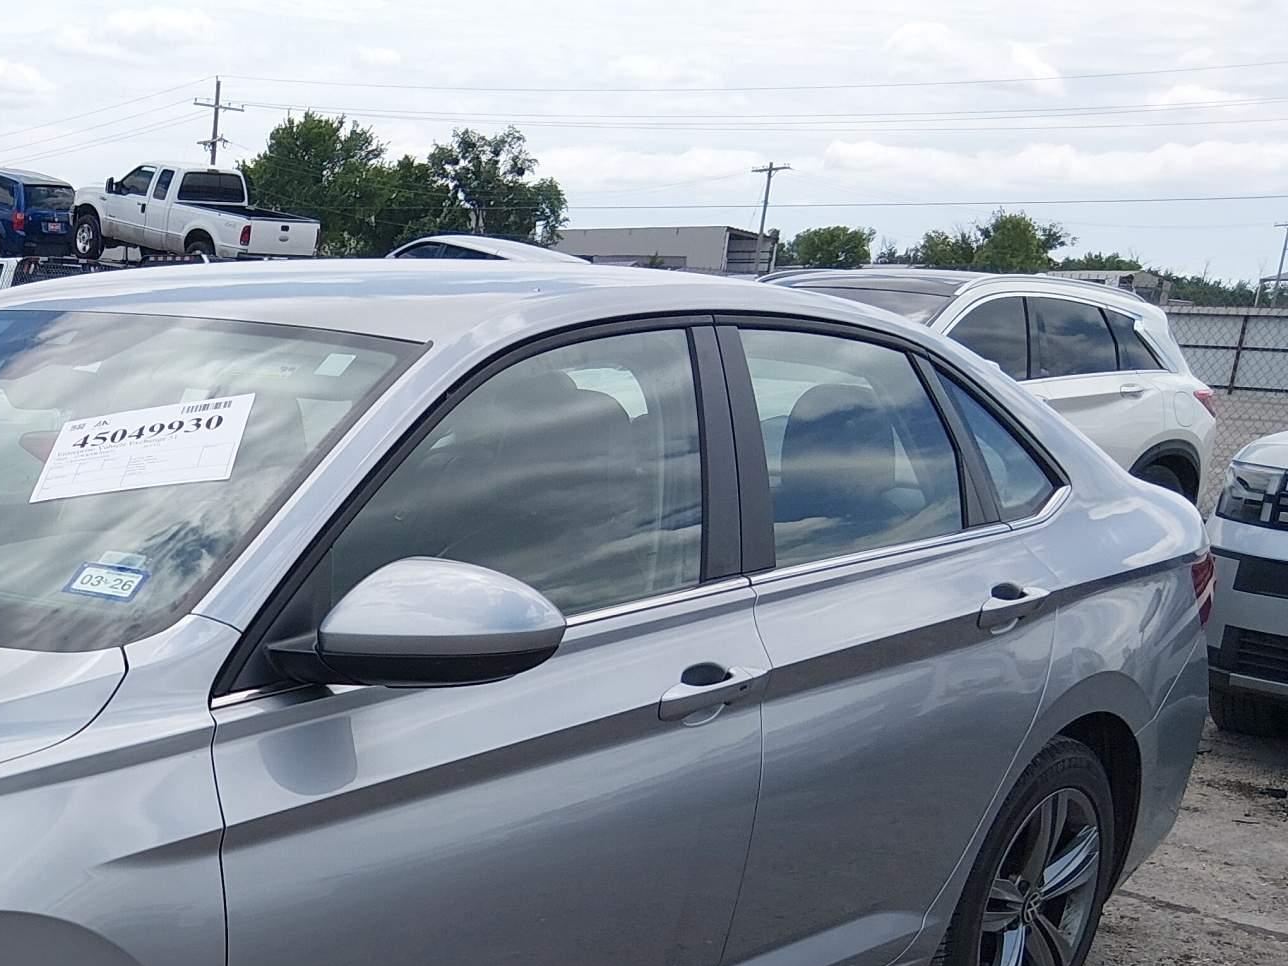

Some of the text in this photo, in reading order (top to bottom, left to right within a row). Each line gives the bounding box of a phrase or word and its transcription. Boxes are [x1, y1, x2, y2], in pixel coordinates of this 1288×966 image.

[72, 414, 223, 448] 45049930
[79, 573, 135, 592] 03 26
